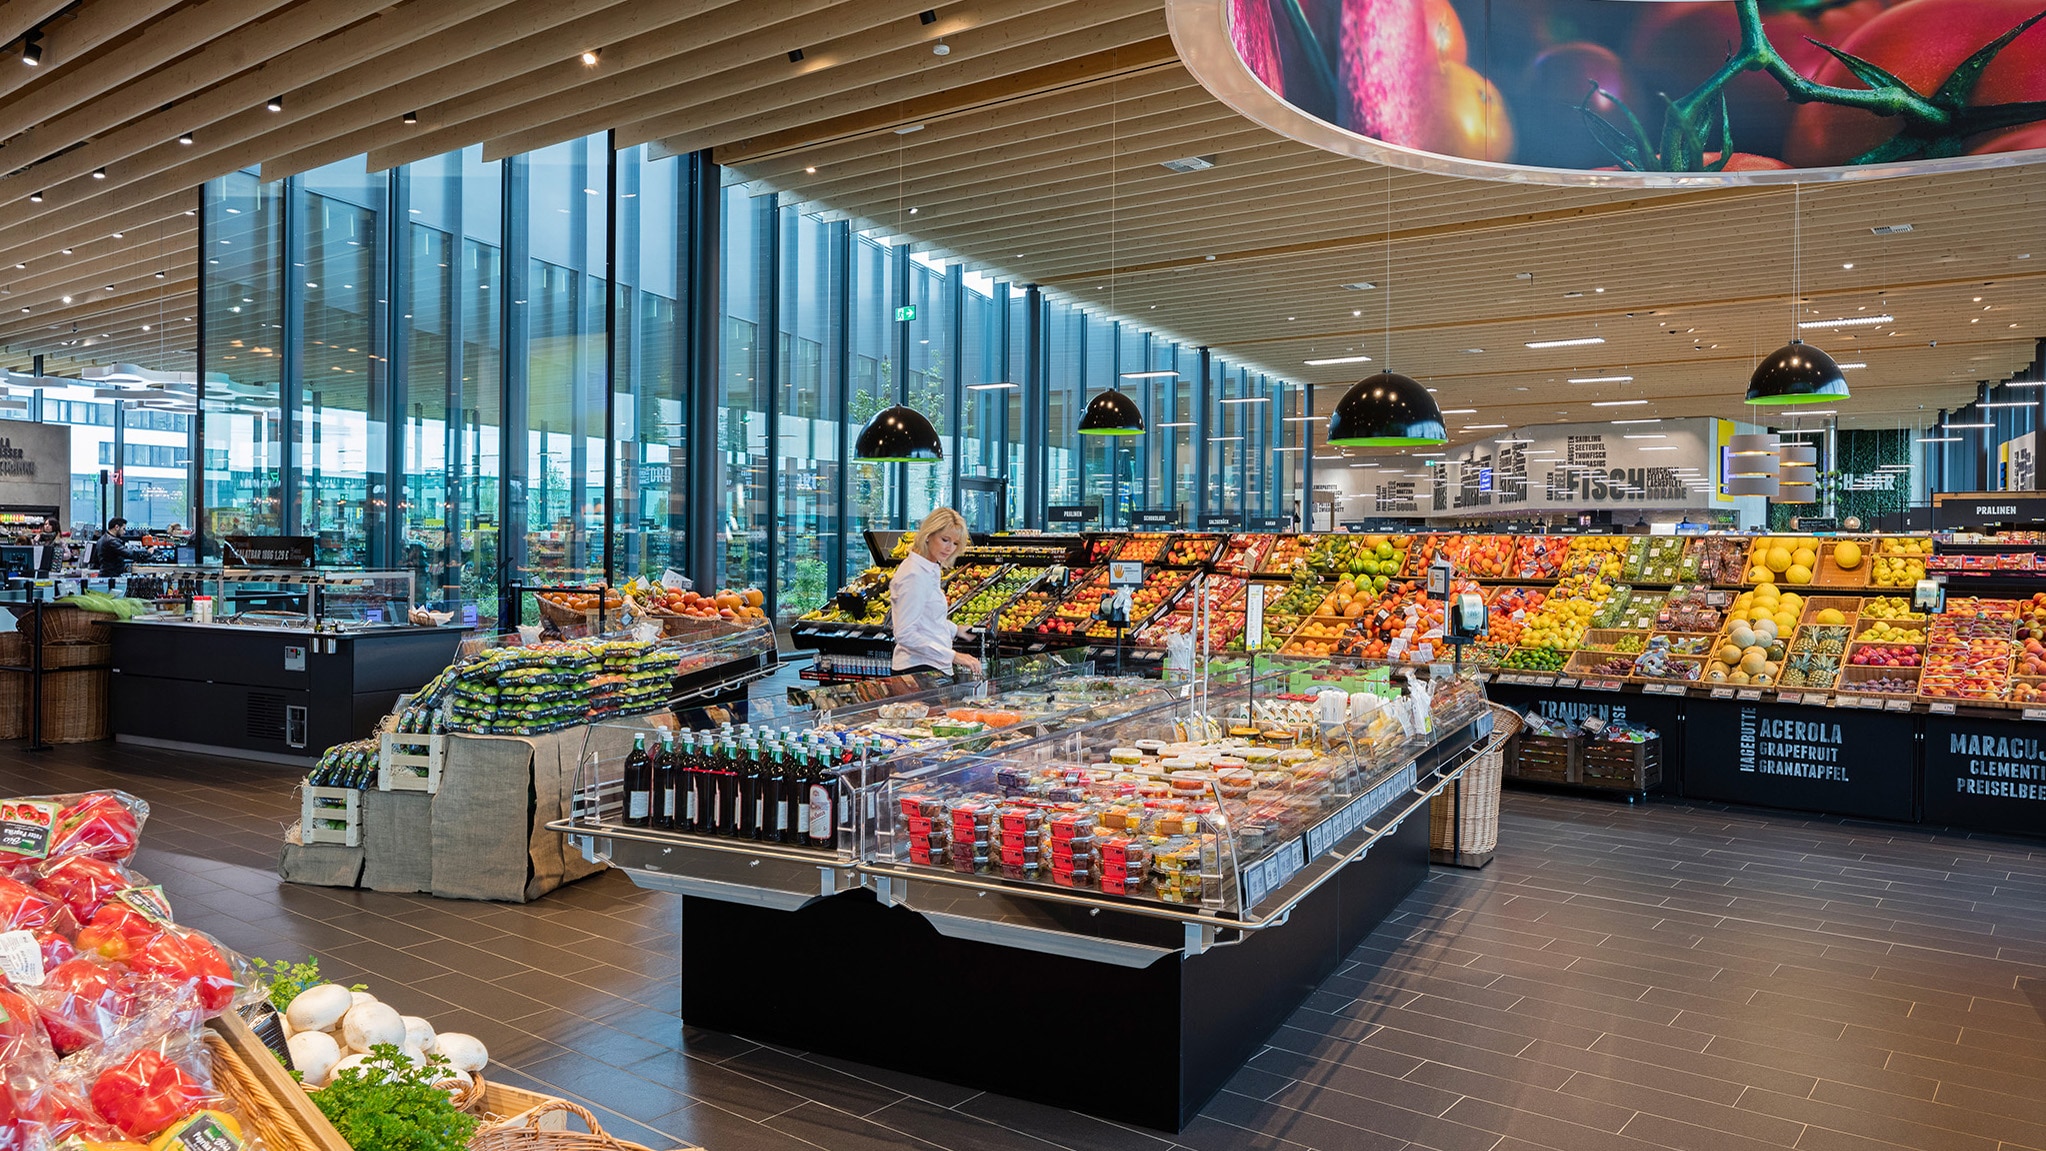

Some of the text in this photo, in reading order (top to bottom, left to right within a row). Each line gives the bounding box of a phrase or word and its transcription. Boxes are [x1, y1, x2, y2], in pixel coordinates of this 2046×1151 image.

[1567, 468, 1645, 501] FISCH
[1647, 488, 1687, 500] DORADE
[1976, 506, 2017, 515] PRALINEN
[1538, 700, 1608, 722] TRAUBEN
[1740, 706, 1756, 772] HAGEBUTTE
[1760, 718, 1842, 744] ACEROLA
[1760, 741, 1838, 762] GRAPEFRUIT
[1759, 759, 1849, 782] GRANATAPFEL
